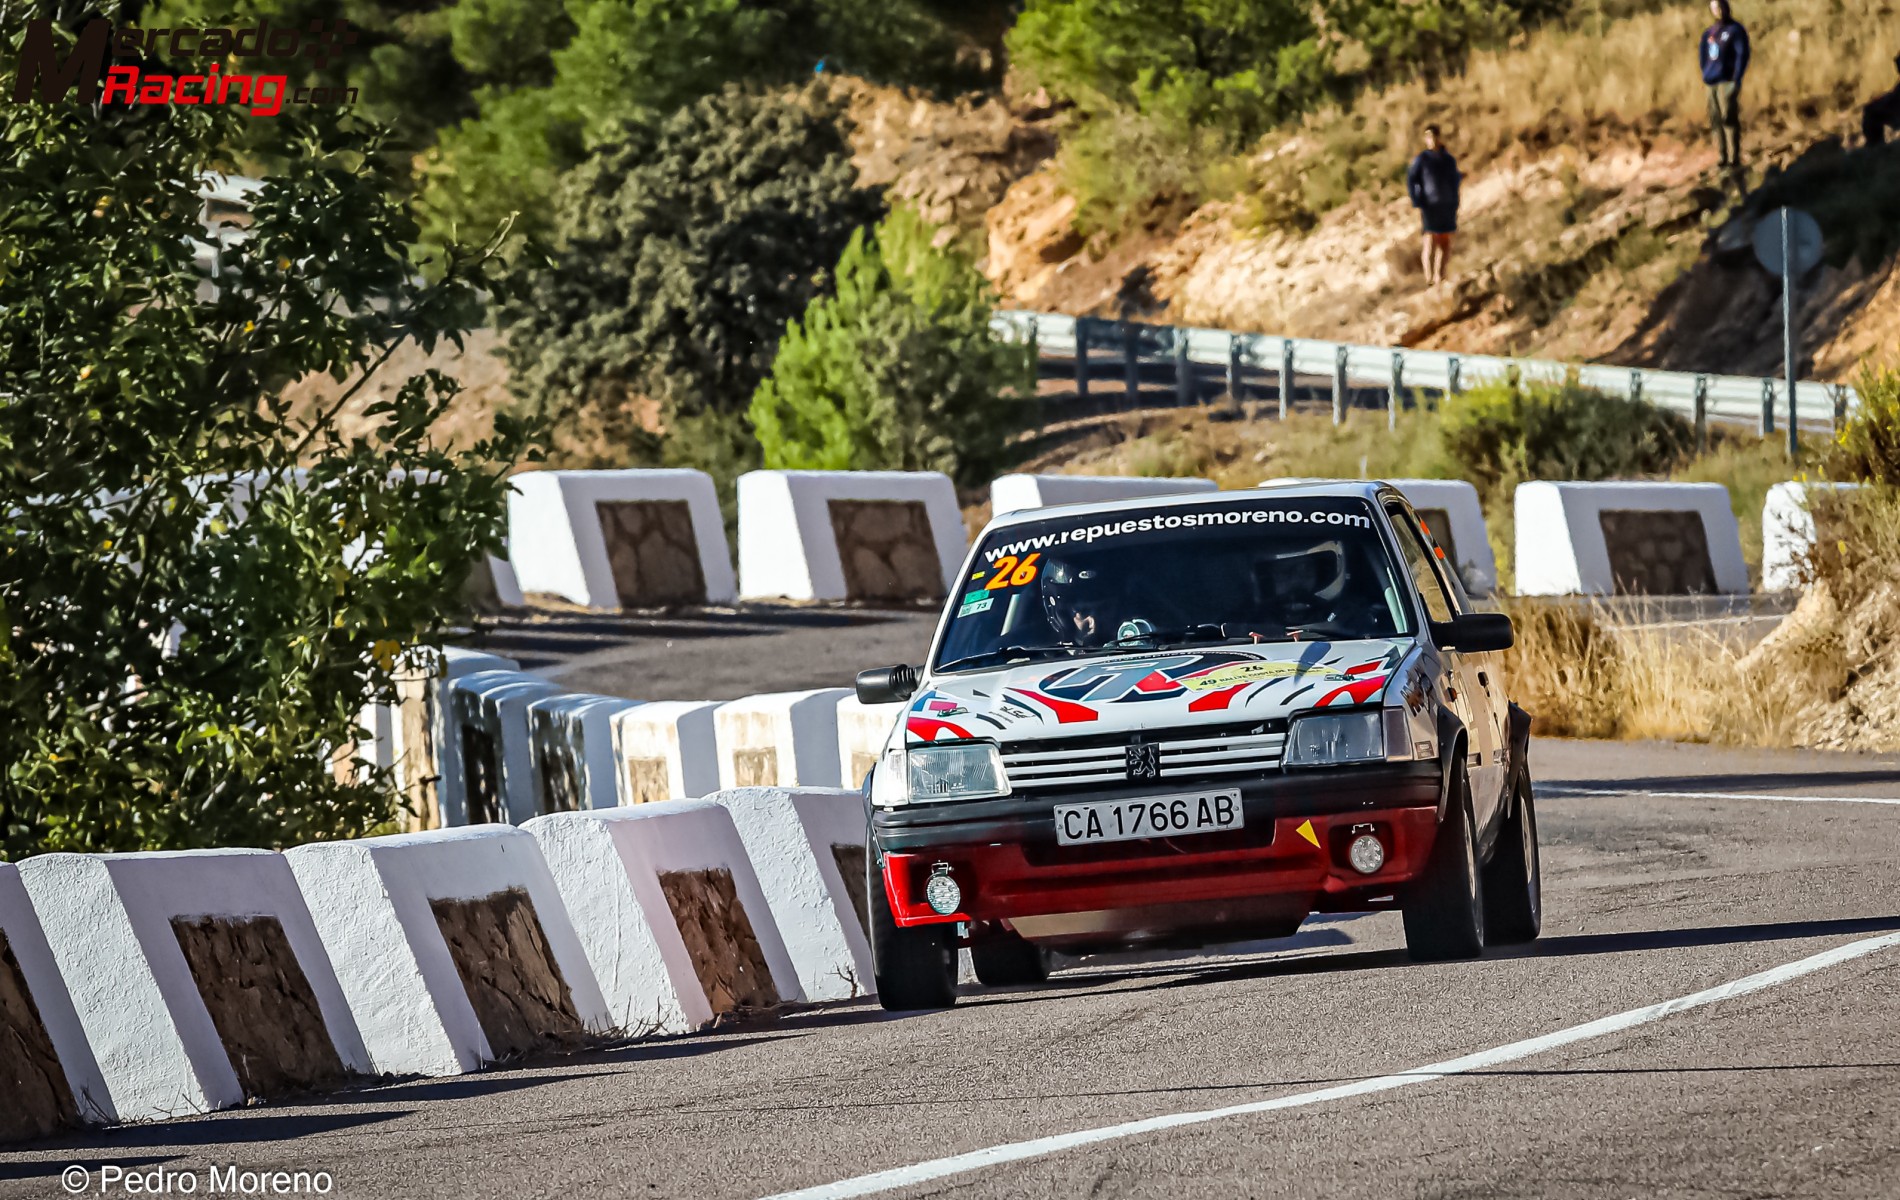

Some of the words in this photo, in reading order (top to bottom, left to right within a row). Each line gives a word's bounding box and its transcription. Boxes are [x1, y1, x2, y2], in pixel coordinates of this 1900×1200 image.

[985, 510, 1370, 562] www.repuestosmoreno.com
[984, 552, 1041, 590] 26
[1240, 665, 1263, 673] 26
[1064, 809, 1104, 840] CA
[1113, 800, 1189, 836] 1766
[1197, 795, 1235, 828] AB
